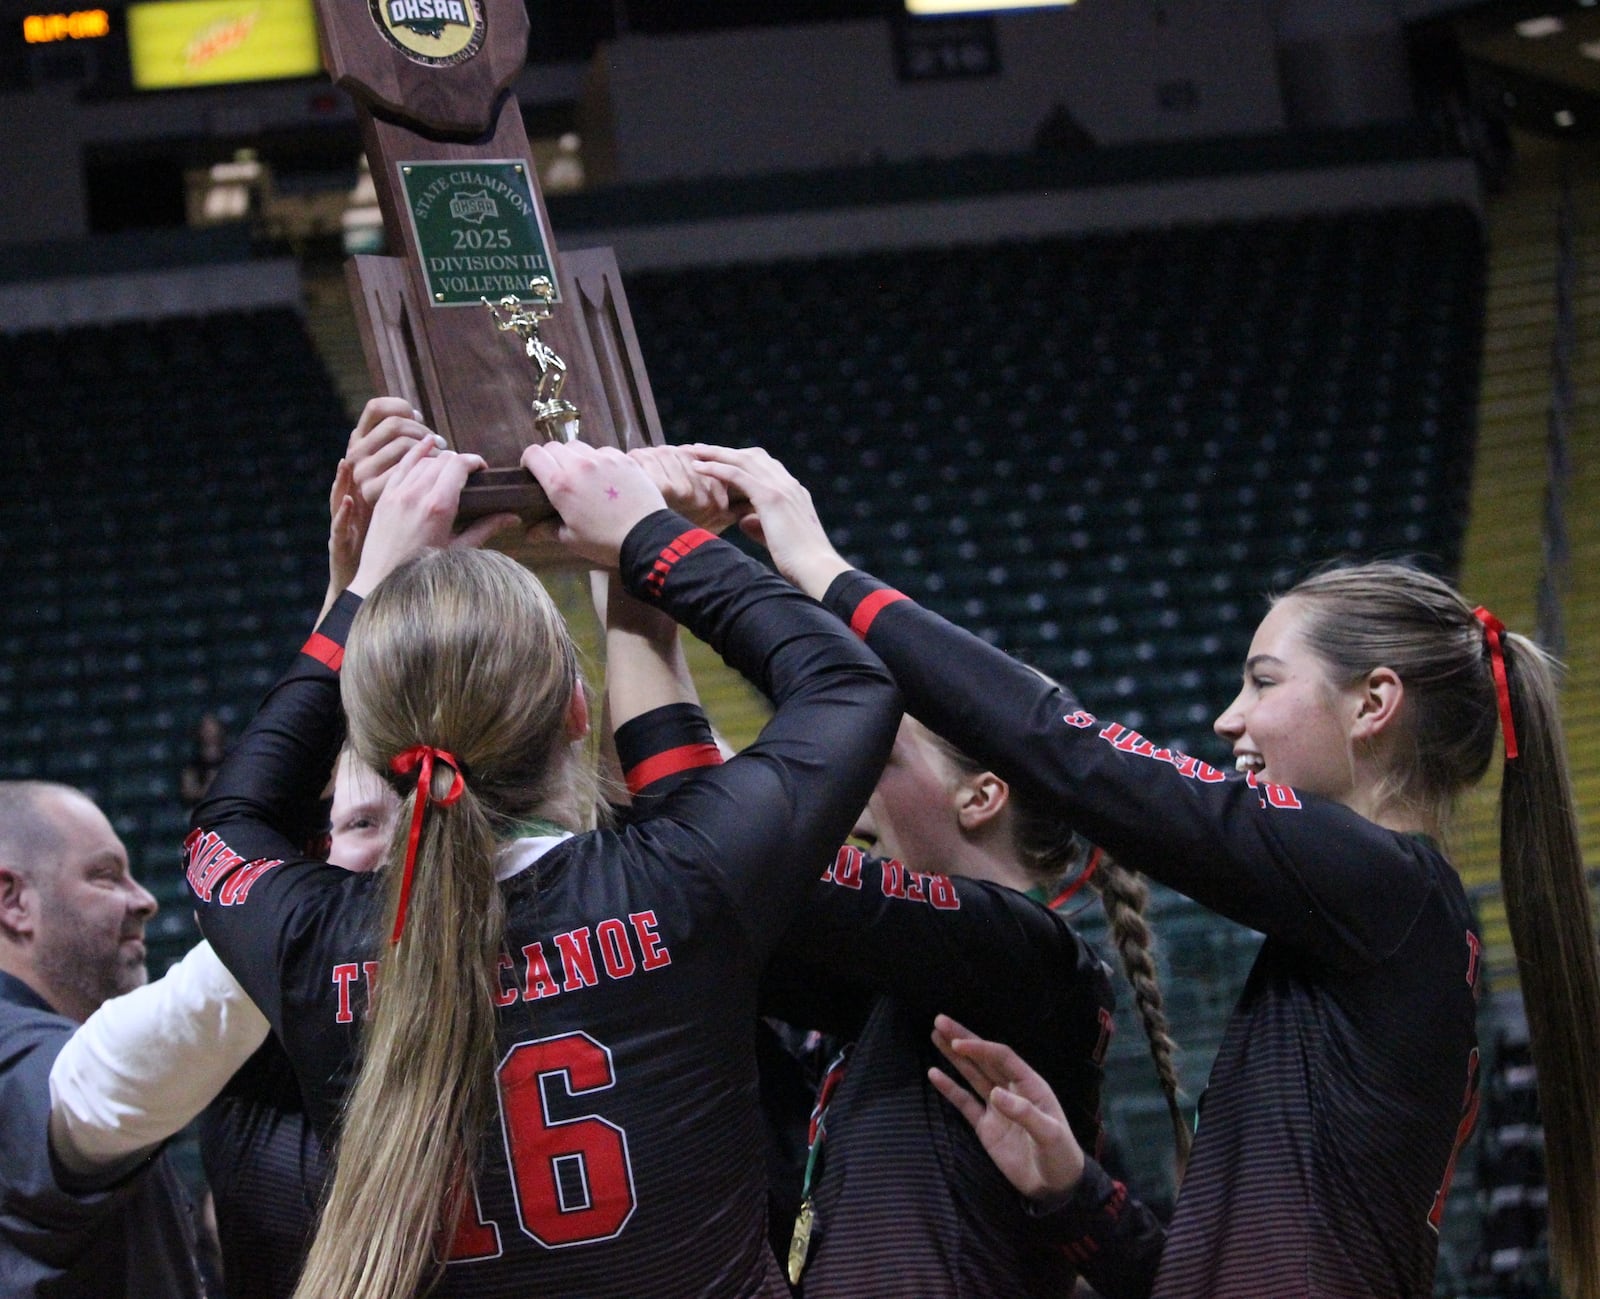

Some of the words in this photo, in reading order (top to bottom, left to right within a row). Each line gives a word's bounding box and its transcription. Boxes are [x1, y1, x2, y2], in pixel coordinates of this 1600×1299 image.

[390, 0, 465, 22] OHSAA
[415, 177, 450, 219] STATE
[450, 171, 532, 217] CHAMPION
[453, 199, 494, 214] OHSAA
[451, 229, 512, 249] 2025
[430, 255, 519, 272] DIVISION
[523, 254, 545, 269] III
[440, 273, 537, 293] VOLLEYBAL
